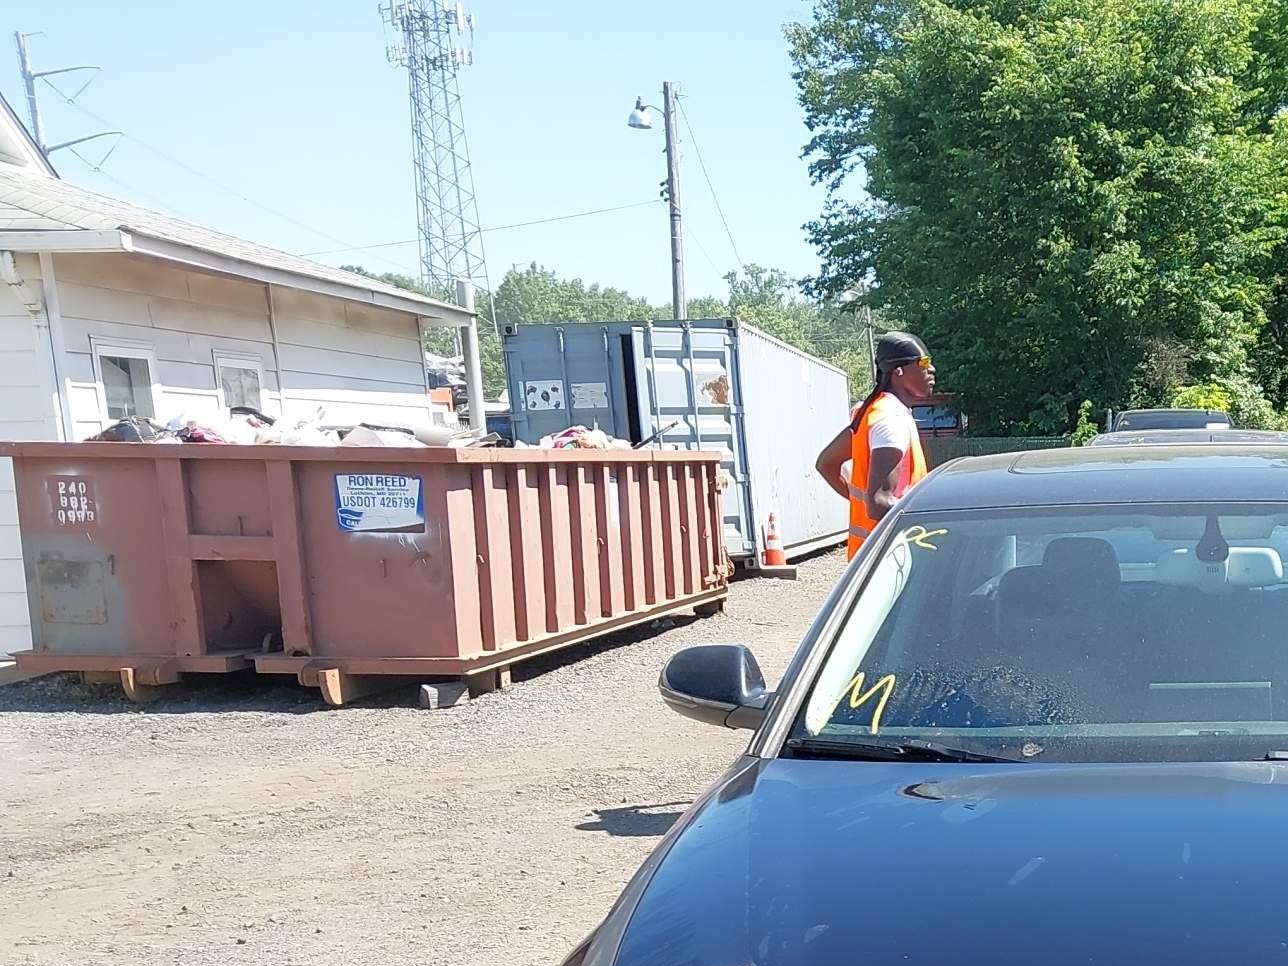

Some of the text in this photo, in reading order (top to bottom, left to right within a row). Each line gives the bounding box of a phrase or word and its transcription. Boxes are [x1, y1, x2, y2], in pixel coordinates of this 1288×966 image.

[57, 481, 87, 495] 240
[348, 475, 407, 488] RON REED
[342, 495, 416, 508] USDOT 426799
